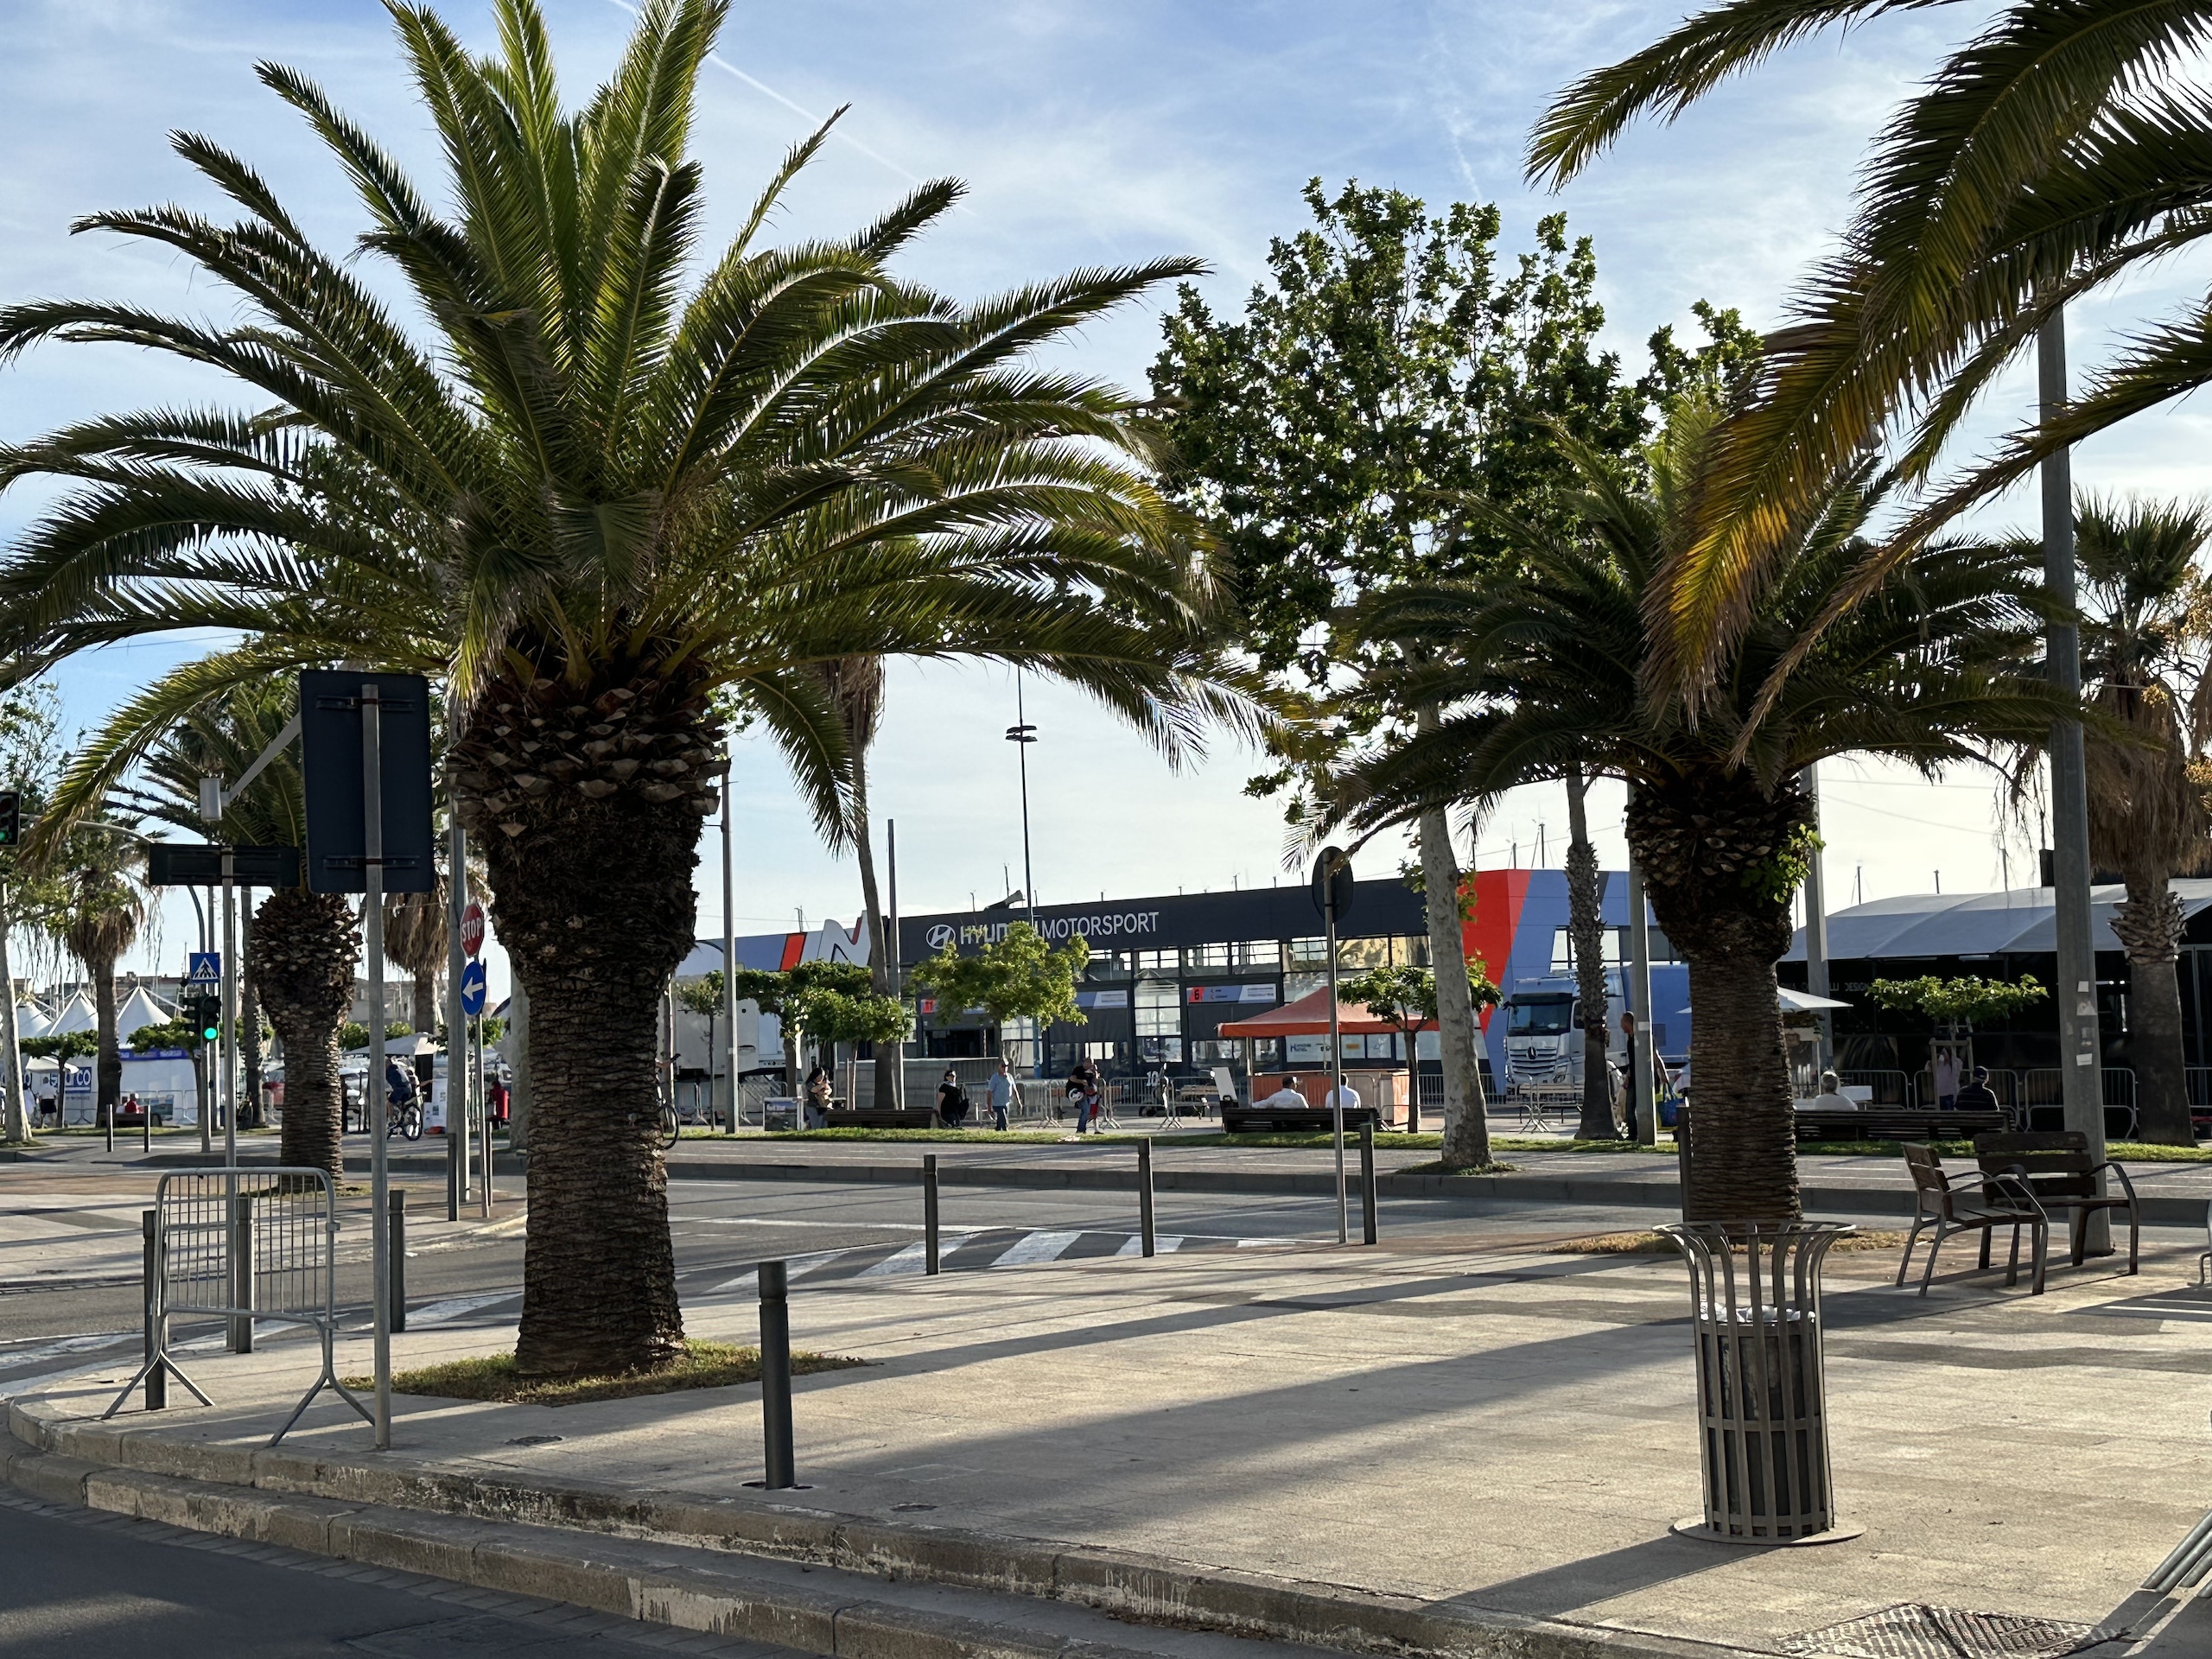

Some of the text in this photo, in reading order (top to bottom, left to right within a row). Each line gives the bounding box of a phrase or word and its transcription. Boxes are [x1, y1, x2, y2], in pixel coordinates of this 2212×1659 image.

[461, 917, 482, 943] STOP
[1041, 912, 1160, 939] MOTORSPORT
[1146, 1071, 1159, 1087] 10
